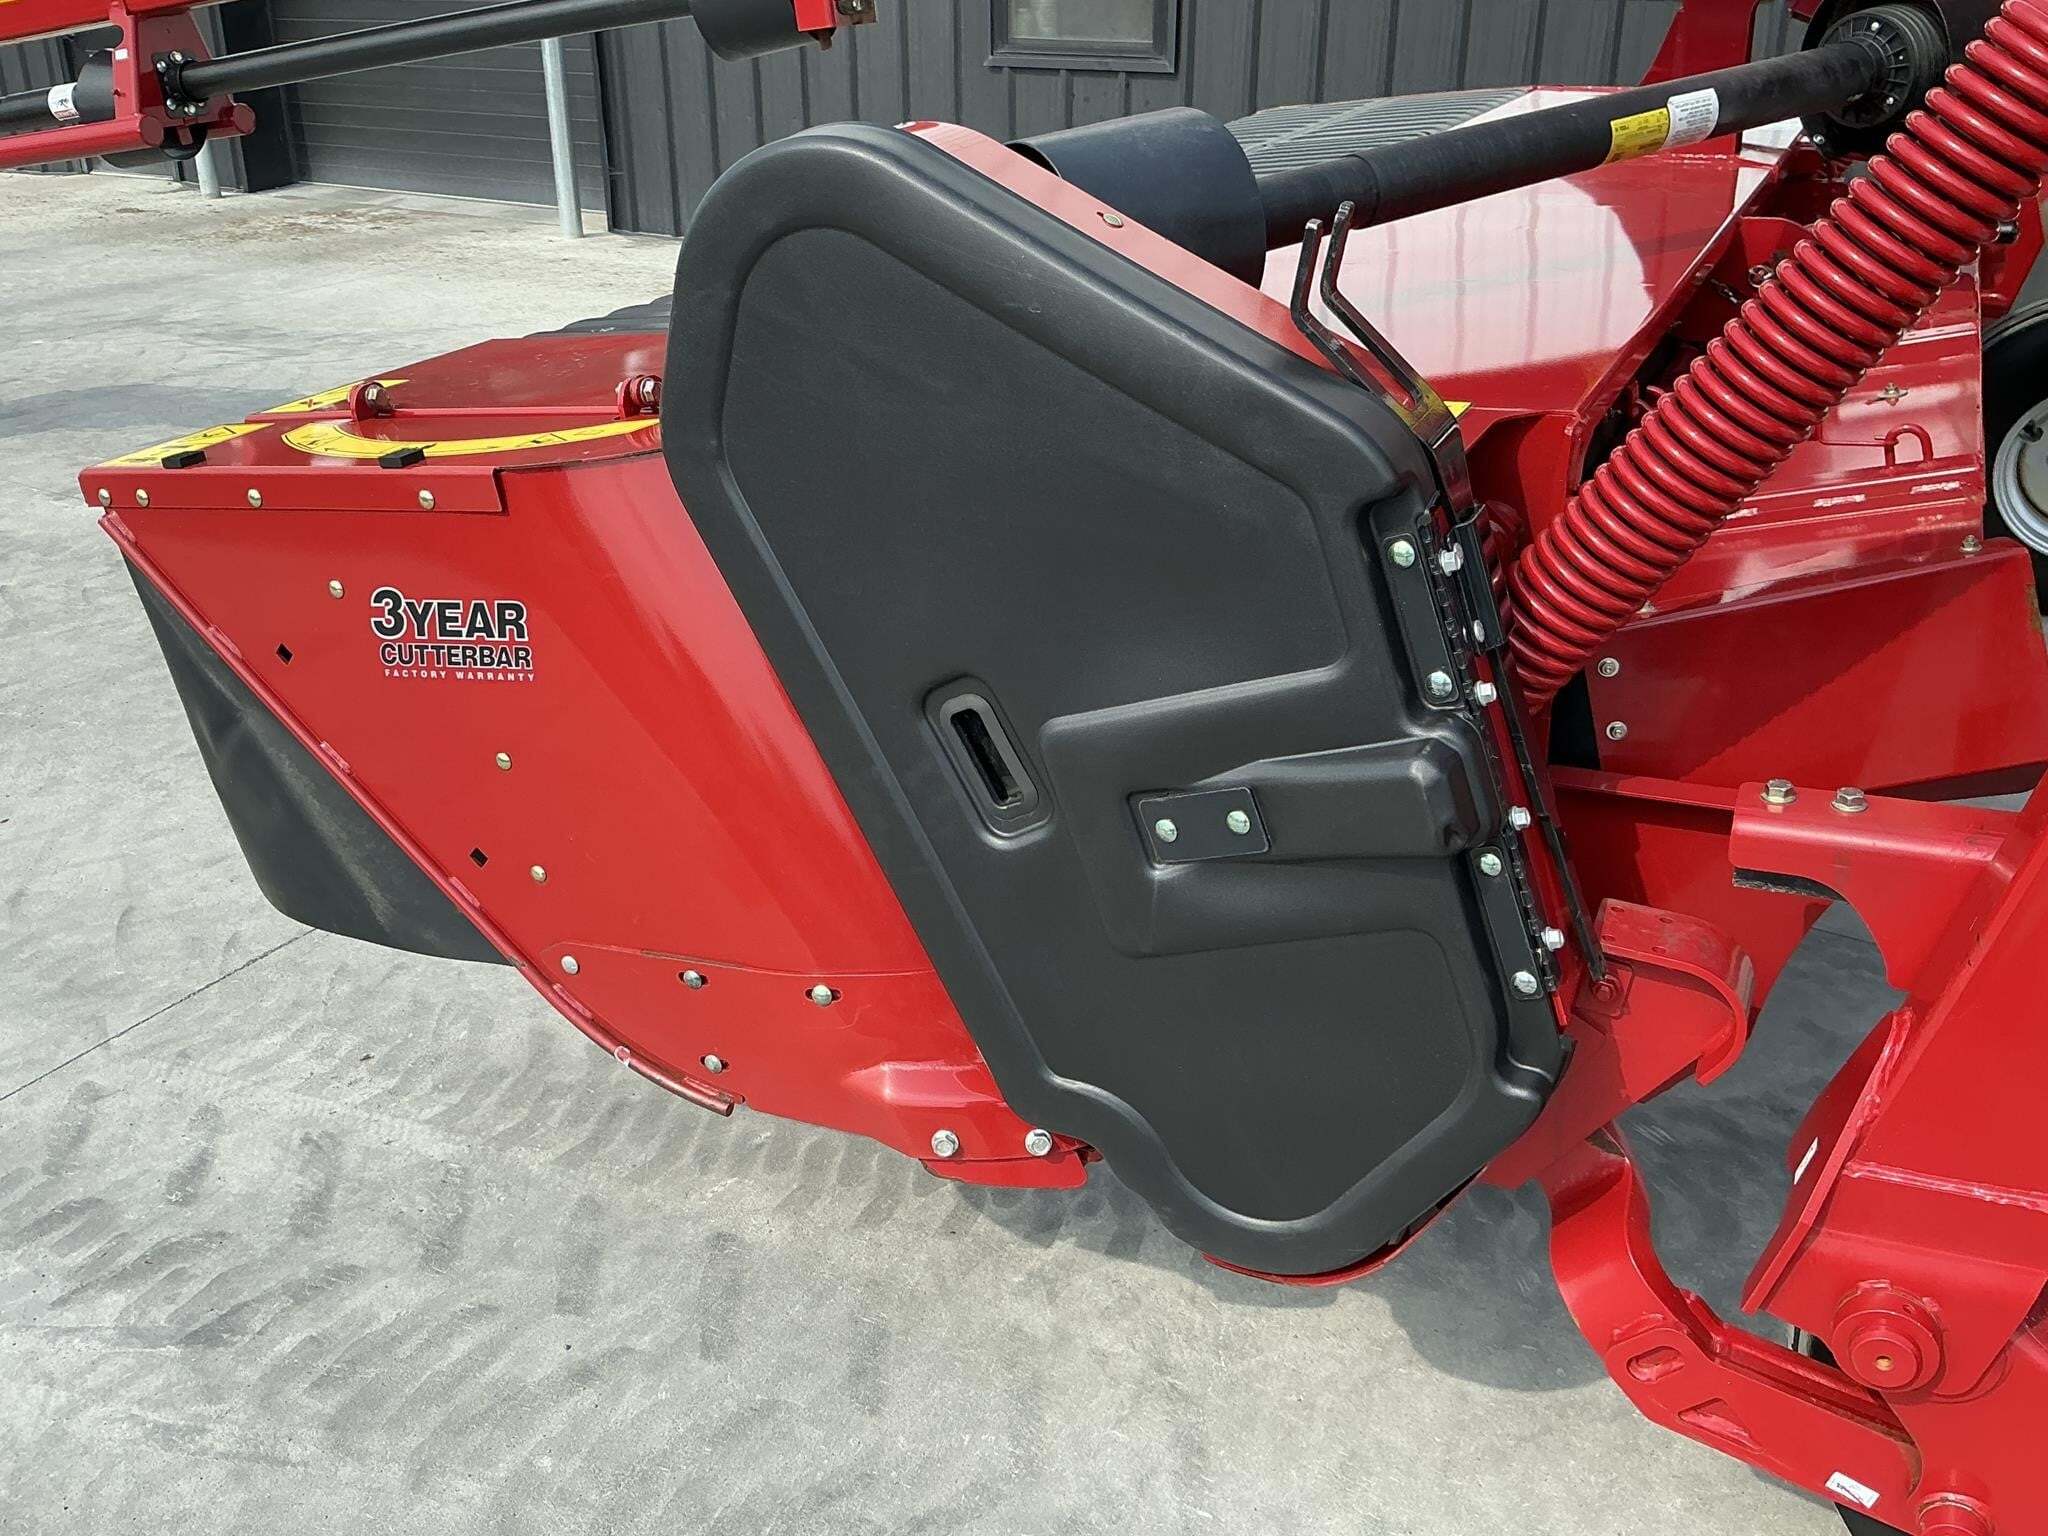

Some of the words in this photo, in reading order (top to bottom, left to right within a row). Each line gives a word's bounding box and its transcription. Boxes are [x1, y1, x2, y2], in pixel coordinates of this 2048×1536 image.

[380, 642, 533, 669] CUTTERBAR
[385, 668, 447, 679] FACTORY
[456, 671, 535, 682] WARRANTY
